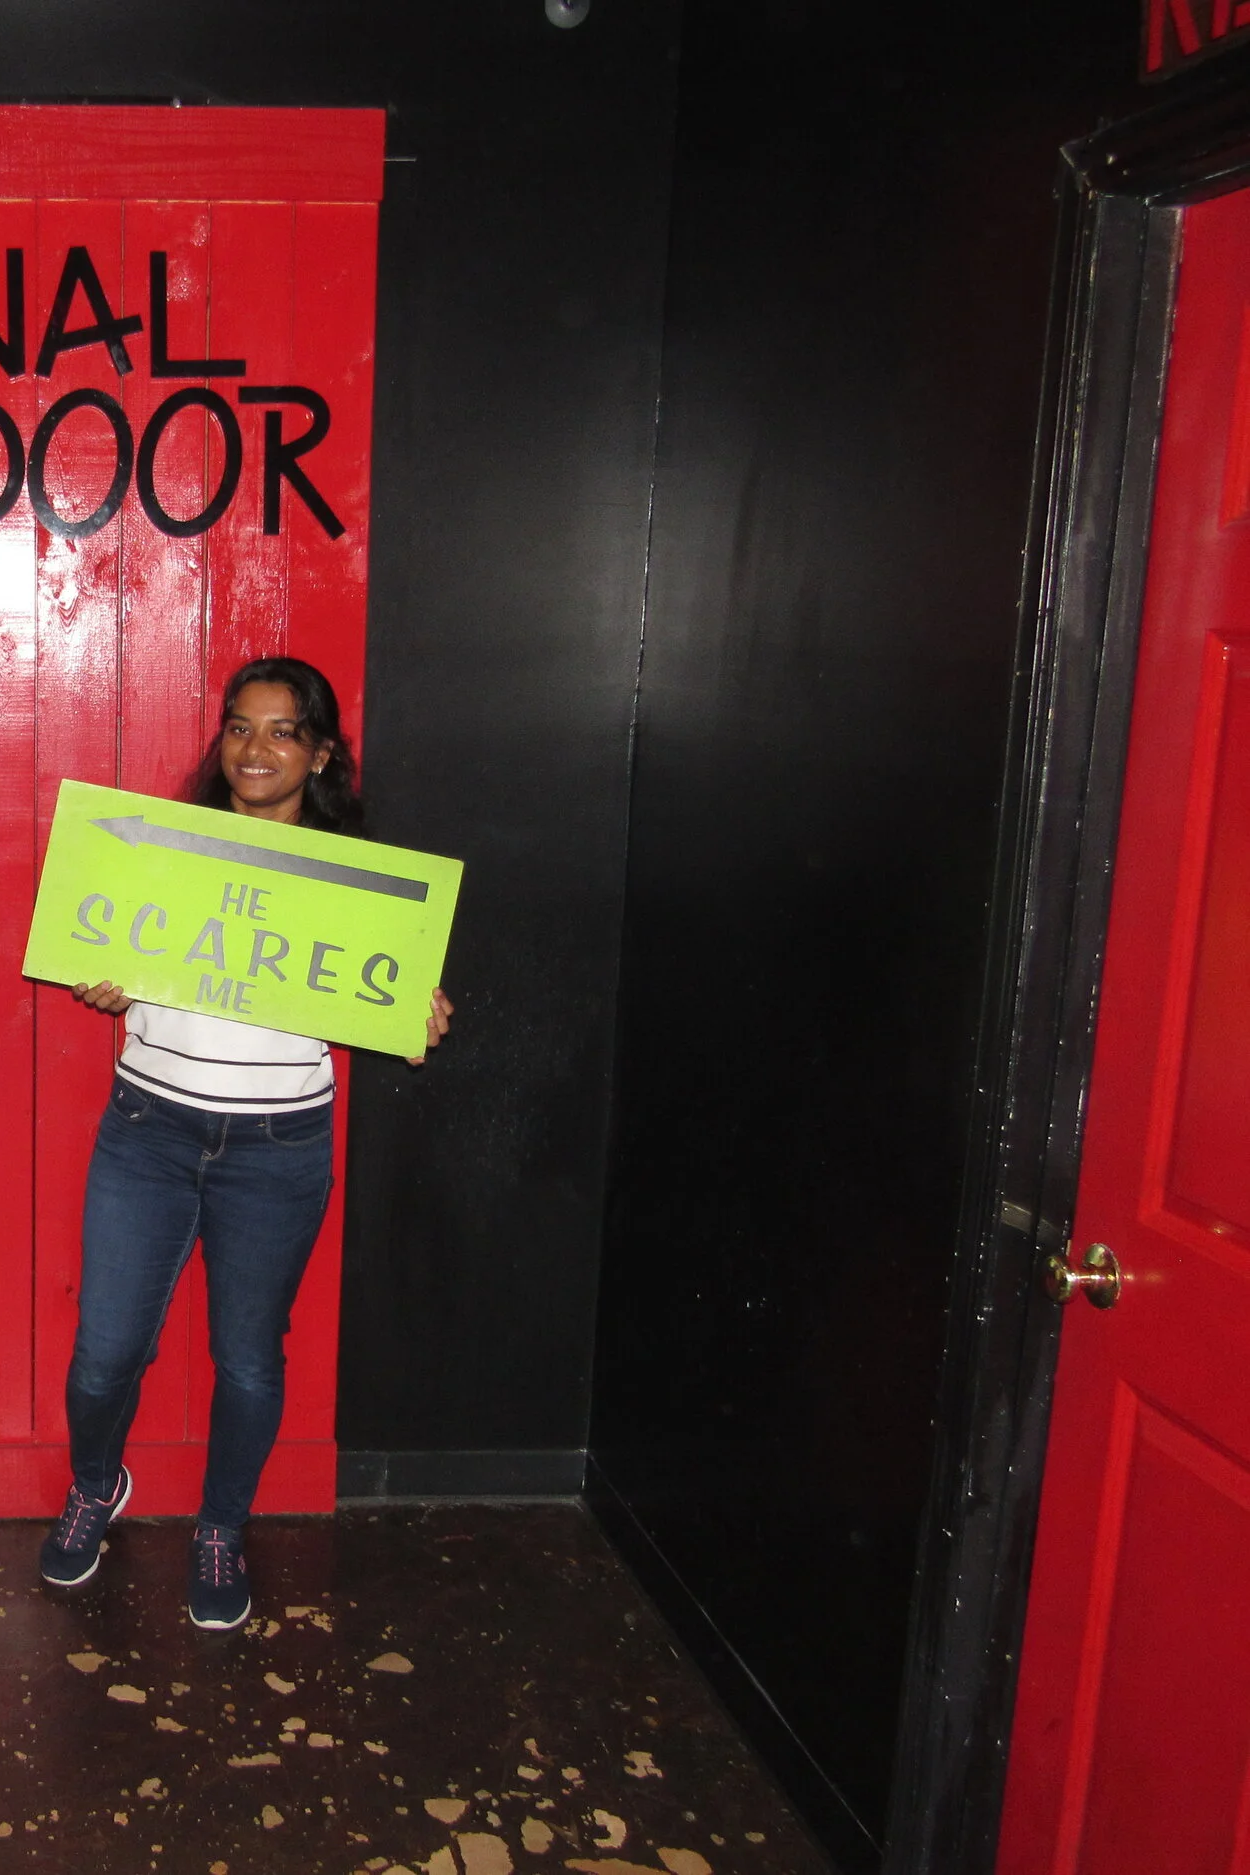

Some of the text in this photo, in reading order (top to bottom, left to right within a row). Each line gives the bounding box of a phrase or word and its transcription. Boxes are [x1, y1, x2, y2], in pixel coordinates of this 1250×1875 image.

[220, 882, 272, 921] HE
[71, 893, 400, 1006] SCARES
[195, 973, 256, 1014] ME
